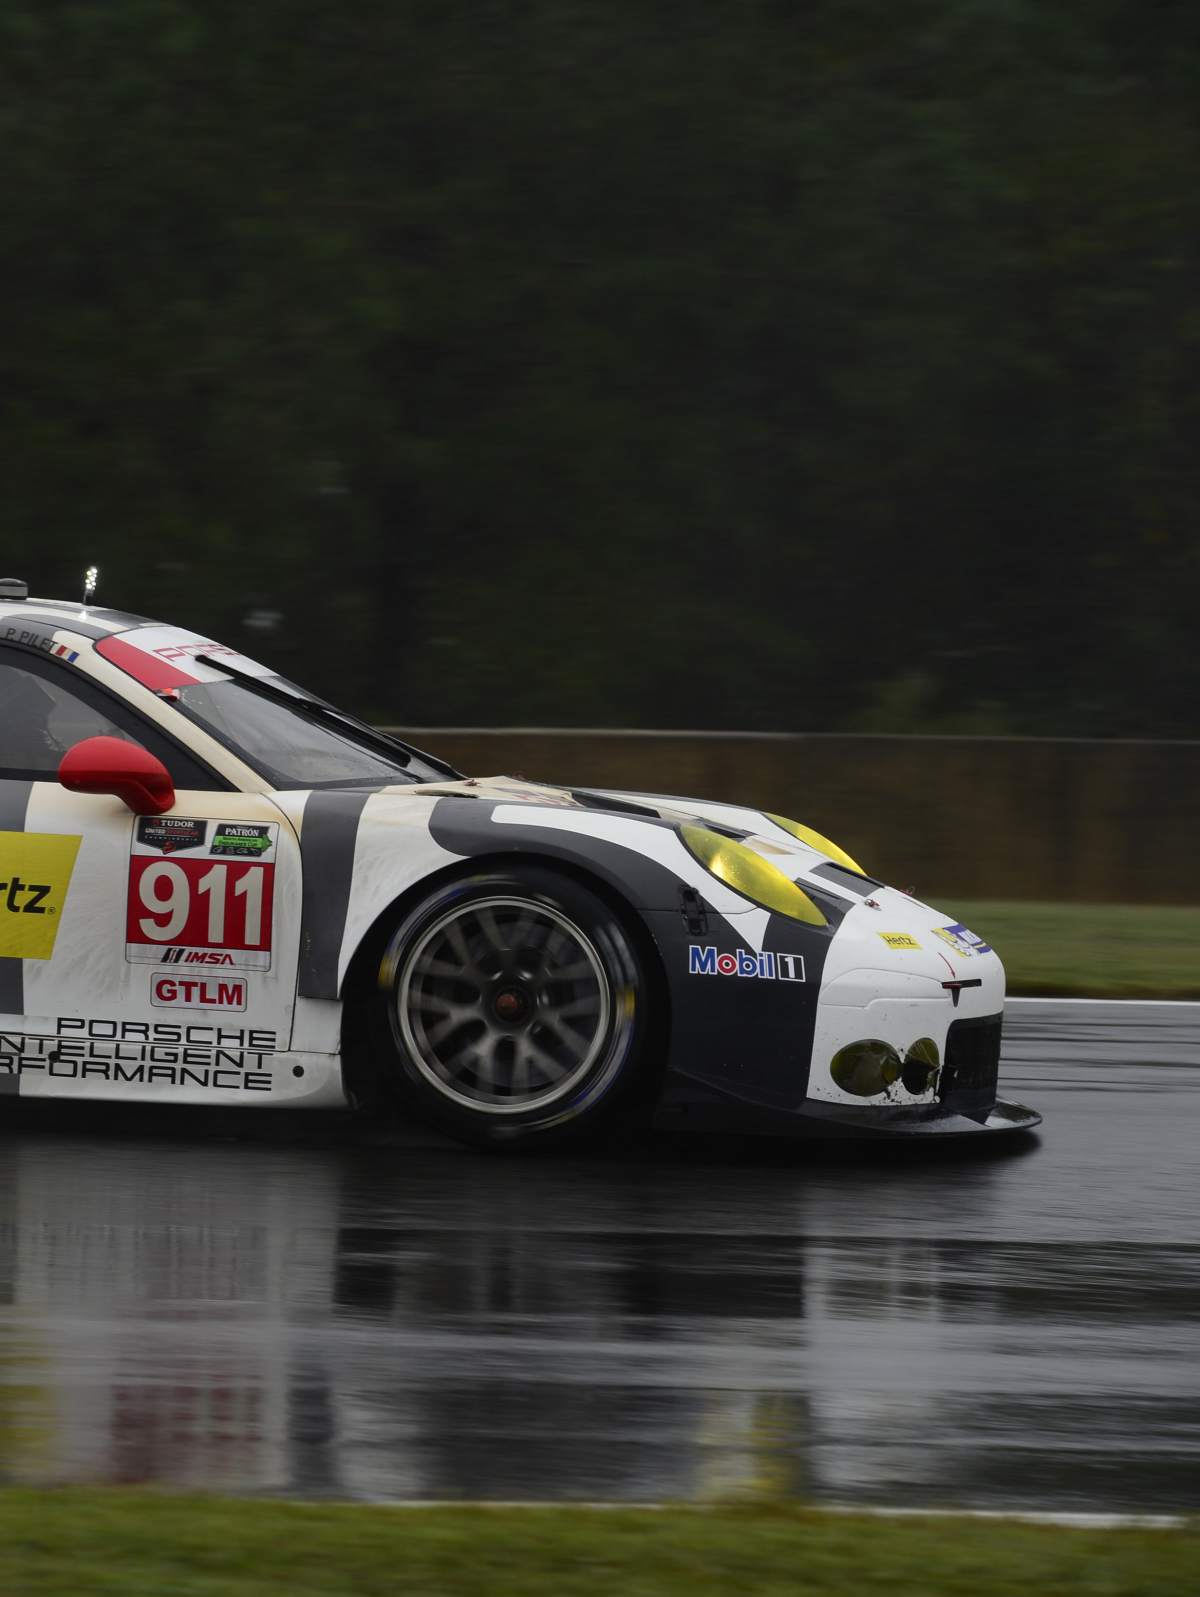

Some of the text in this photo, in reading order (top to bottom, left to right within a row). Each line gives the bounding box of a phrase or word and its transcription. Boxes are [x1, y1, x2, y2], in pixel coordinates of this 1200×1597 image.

[18, 630, 59, 652] PILET
[160, 819, 195, 829] TUDOR
[224, 826, 260, 837] PATRÓN
[138, 860, 265, 946] 911
[184, 951, 235, 966] IMSA
[688, 944, 776, 980] Mobil
[155, 979, 243, 1006] GTLM
[56, 1016, 277, 1050] PORSCHE
